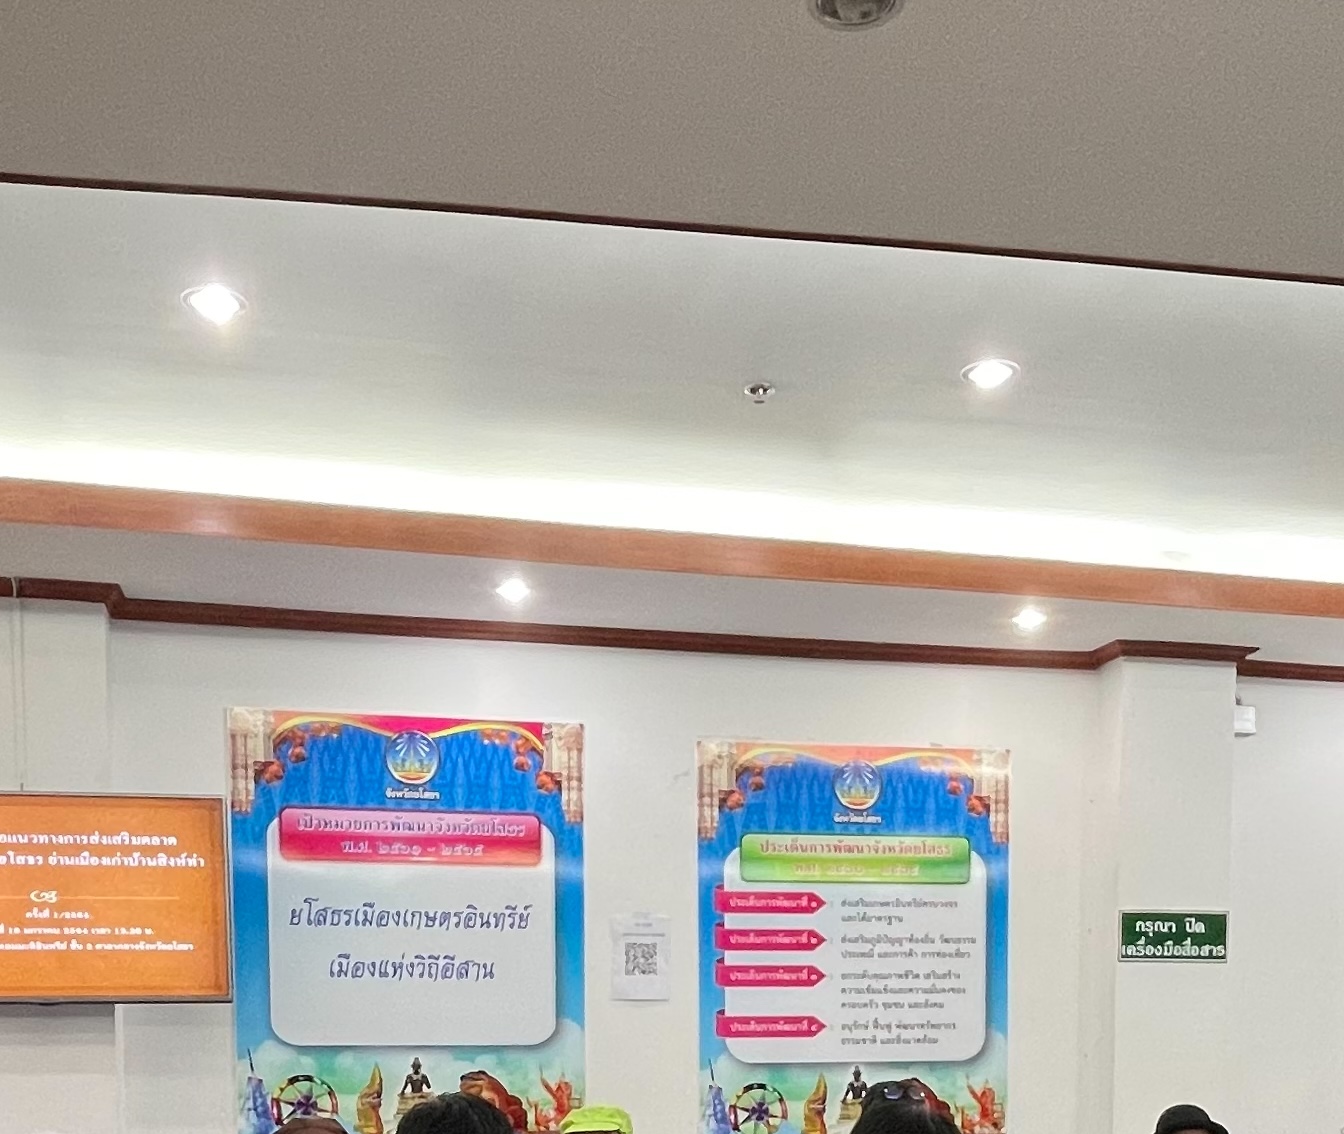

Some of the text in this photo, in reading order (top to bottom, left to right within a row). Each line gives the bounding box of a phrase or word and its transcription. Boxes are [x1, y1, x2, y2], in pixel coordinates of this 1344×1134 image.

[289, 897, 533, 932] ยโสธรเมืองเกษตรอินทรีย์
[1135, 917, 1206, 937] กรุณา ปิด
[1121, 935, 1226, 957] เครื่องมือสื่อสาร
[329, 951, 495, 982] เมืองแห่งวิถีอีสาน
